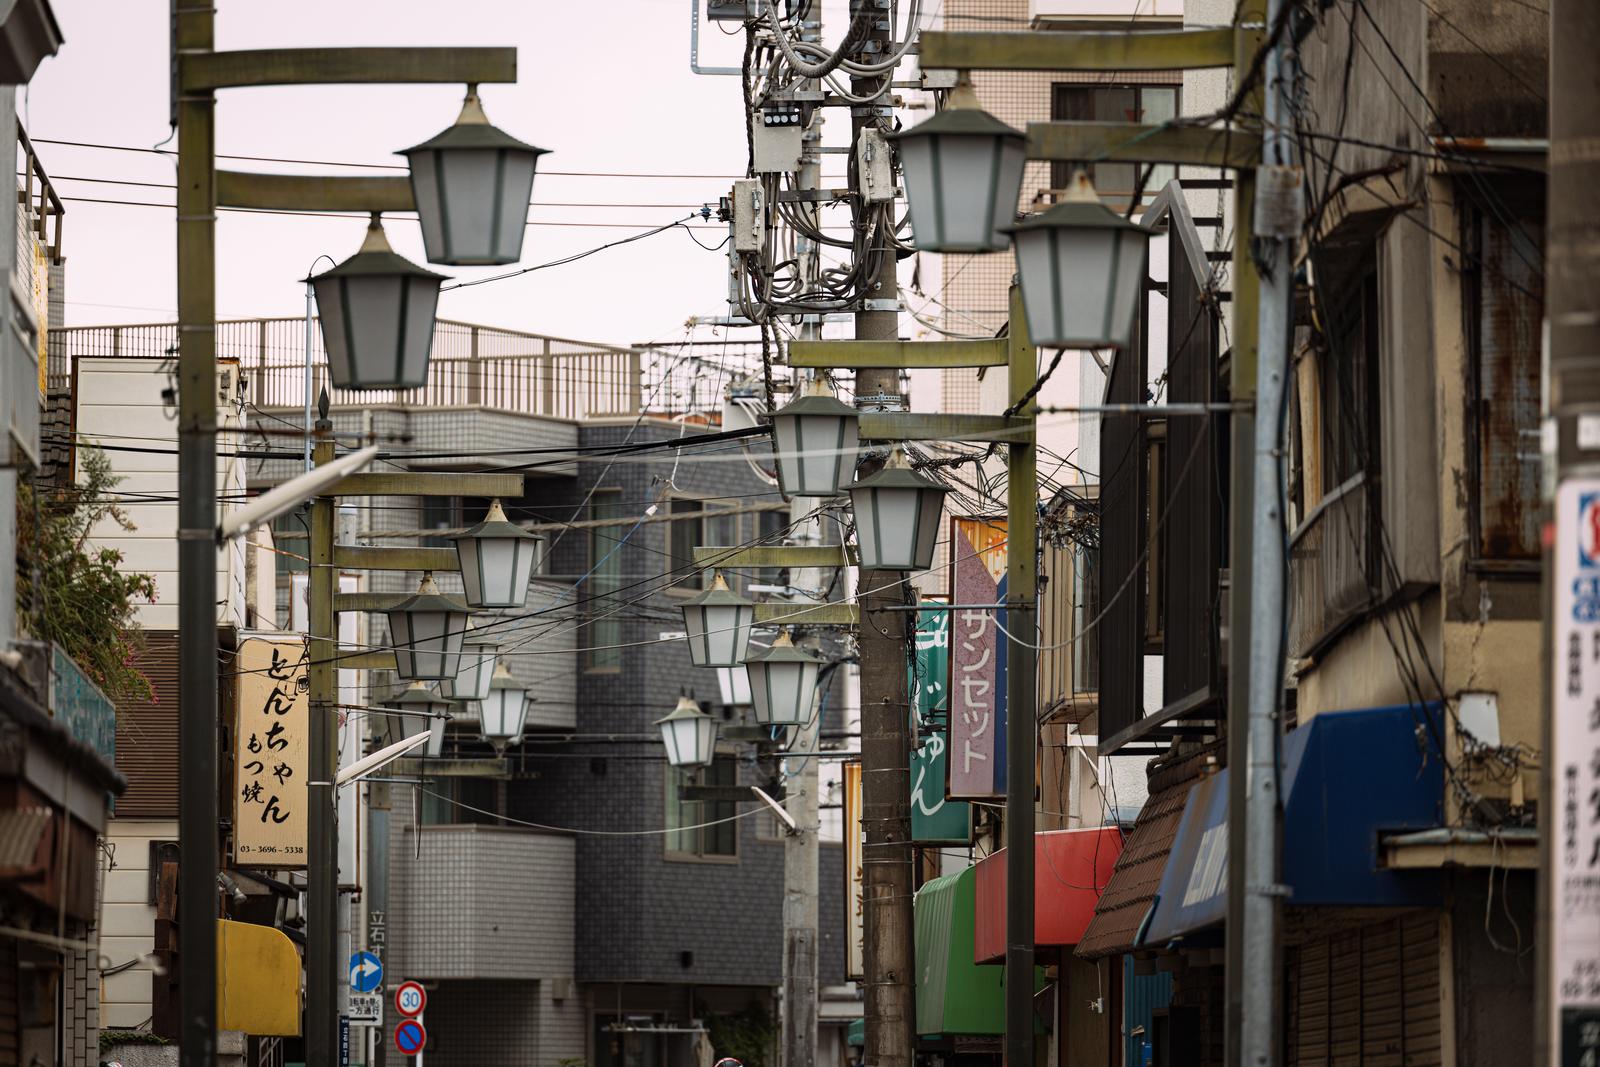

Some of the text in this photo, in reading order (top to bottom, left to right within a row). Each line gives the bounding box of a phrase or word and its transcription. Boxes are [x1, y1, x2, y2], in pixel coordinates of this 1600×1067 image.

[261, 647, 293, 824] とんちゃん
[960, 607, 991, 774] サンセット
[241, 732, 265, 804] もつ焼
[402, 991, 419, 1008] 30
